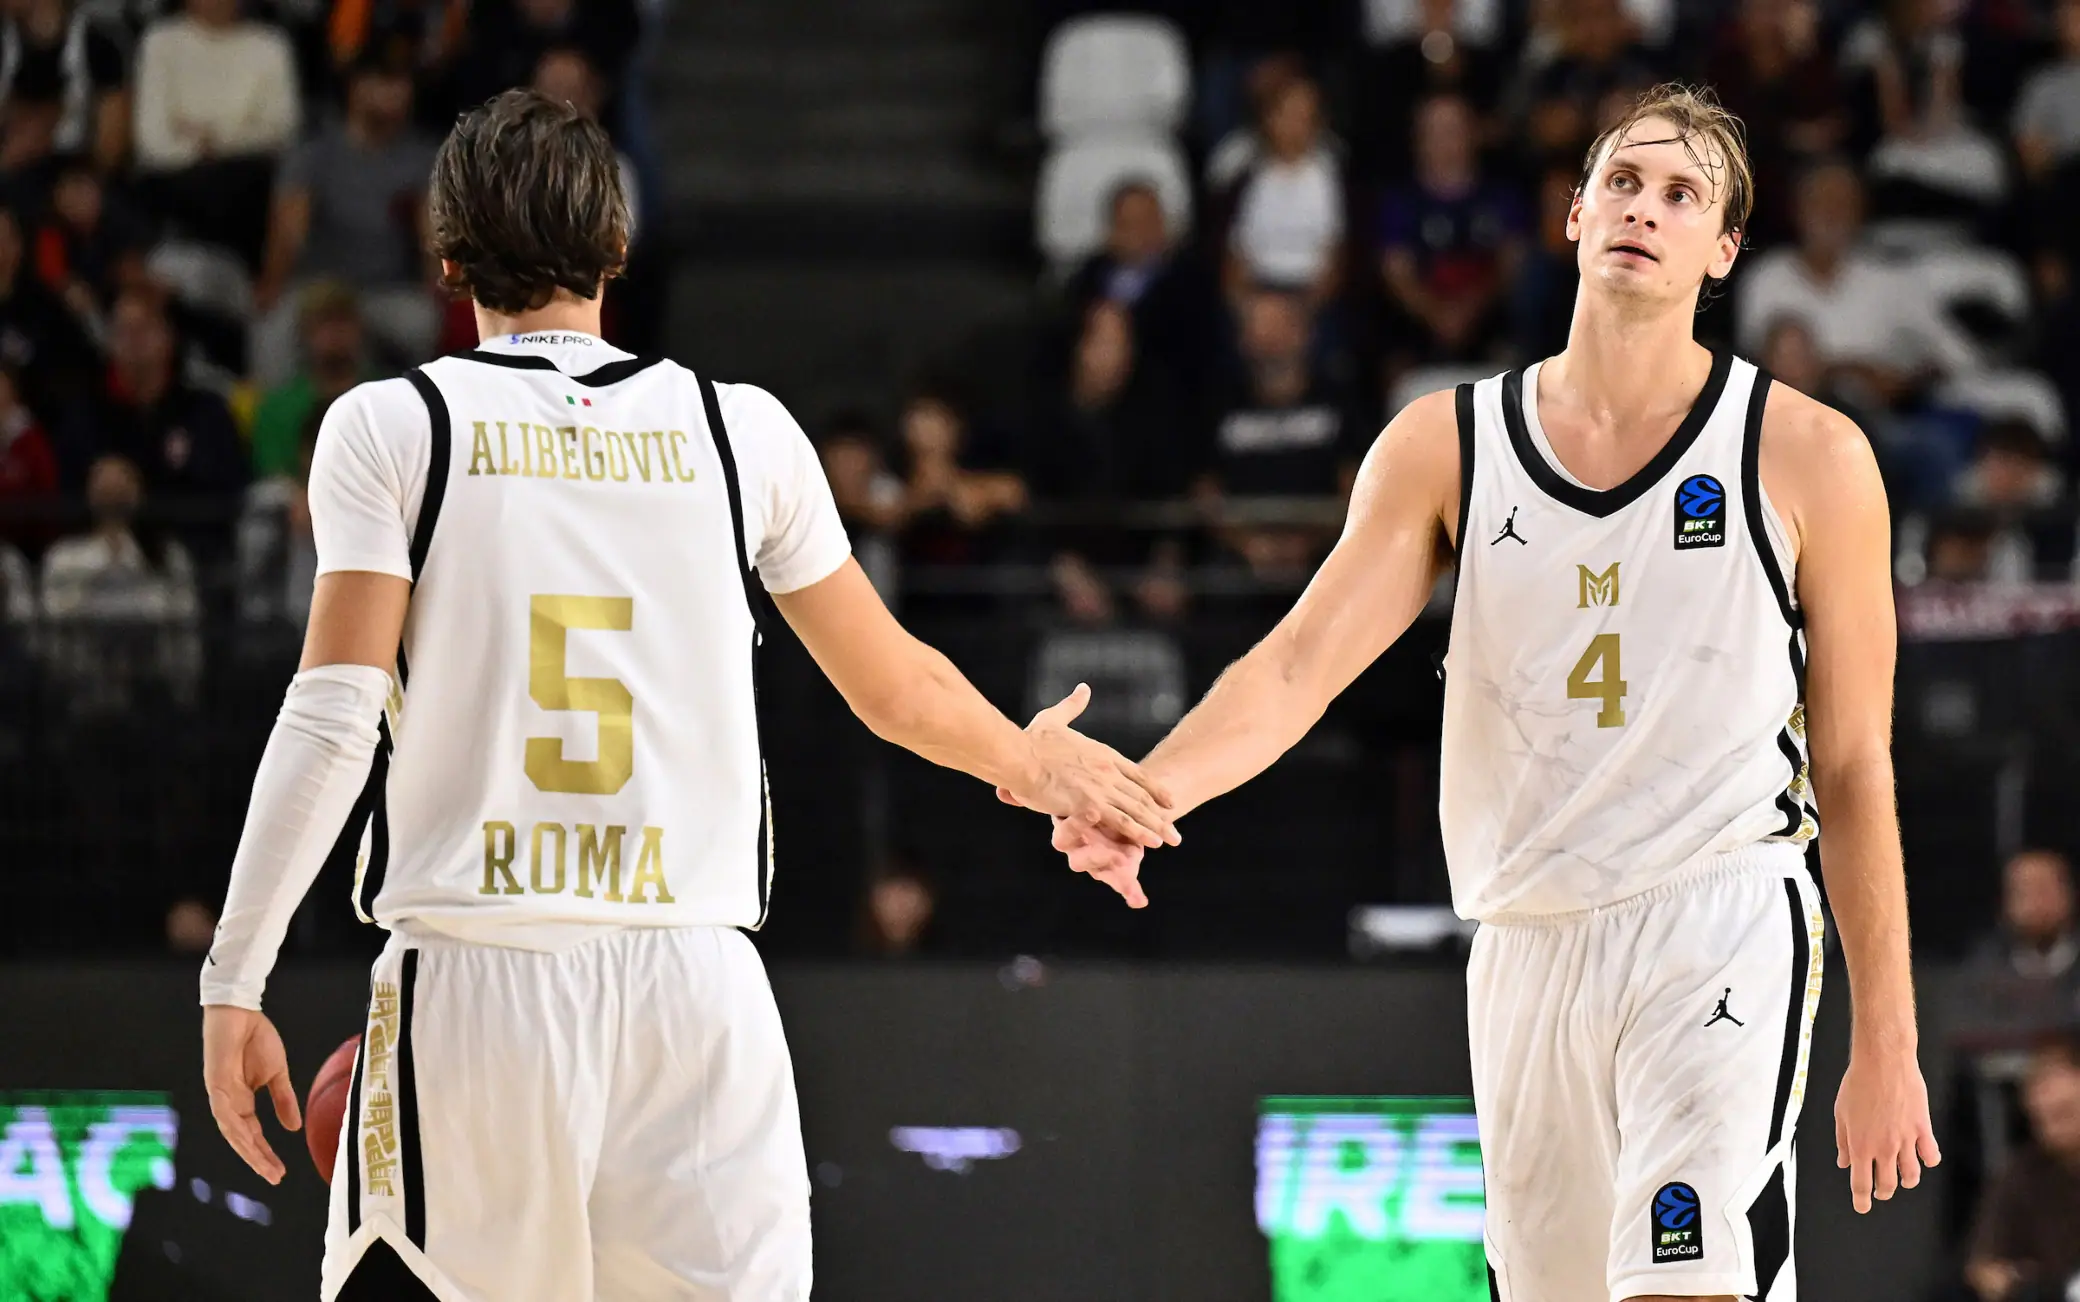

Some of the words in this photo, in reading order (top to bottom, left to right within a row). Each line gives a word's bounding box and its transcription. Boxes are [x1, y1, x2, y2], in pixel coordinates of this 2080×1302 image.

[521, 335, 560, 345] NIKE
[562, 335, 593, 347] PRO
[468, 420, 696, 484] ALIBEGOVIC
[1683, 519, 1717, 533] BKT
[1678, 532, 1722, 544] EuroCup
[1566, 632, 1628, 729] 4
[524, 593, 634, 796] 5
[478, 820, 676, 904] ROMA
[1660, 1231, 1693, 1245] BKT
[1656, 1244, 1699, 1257] EuroCup
